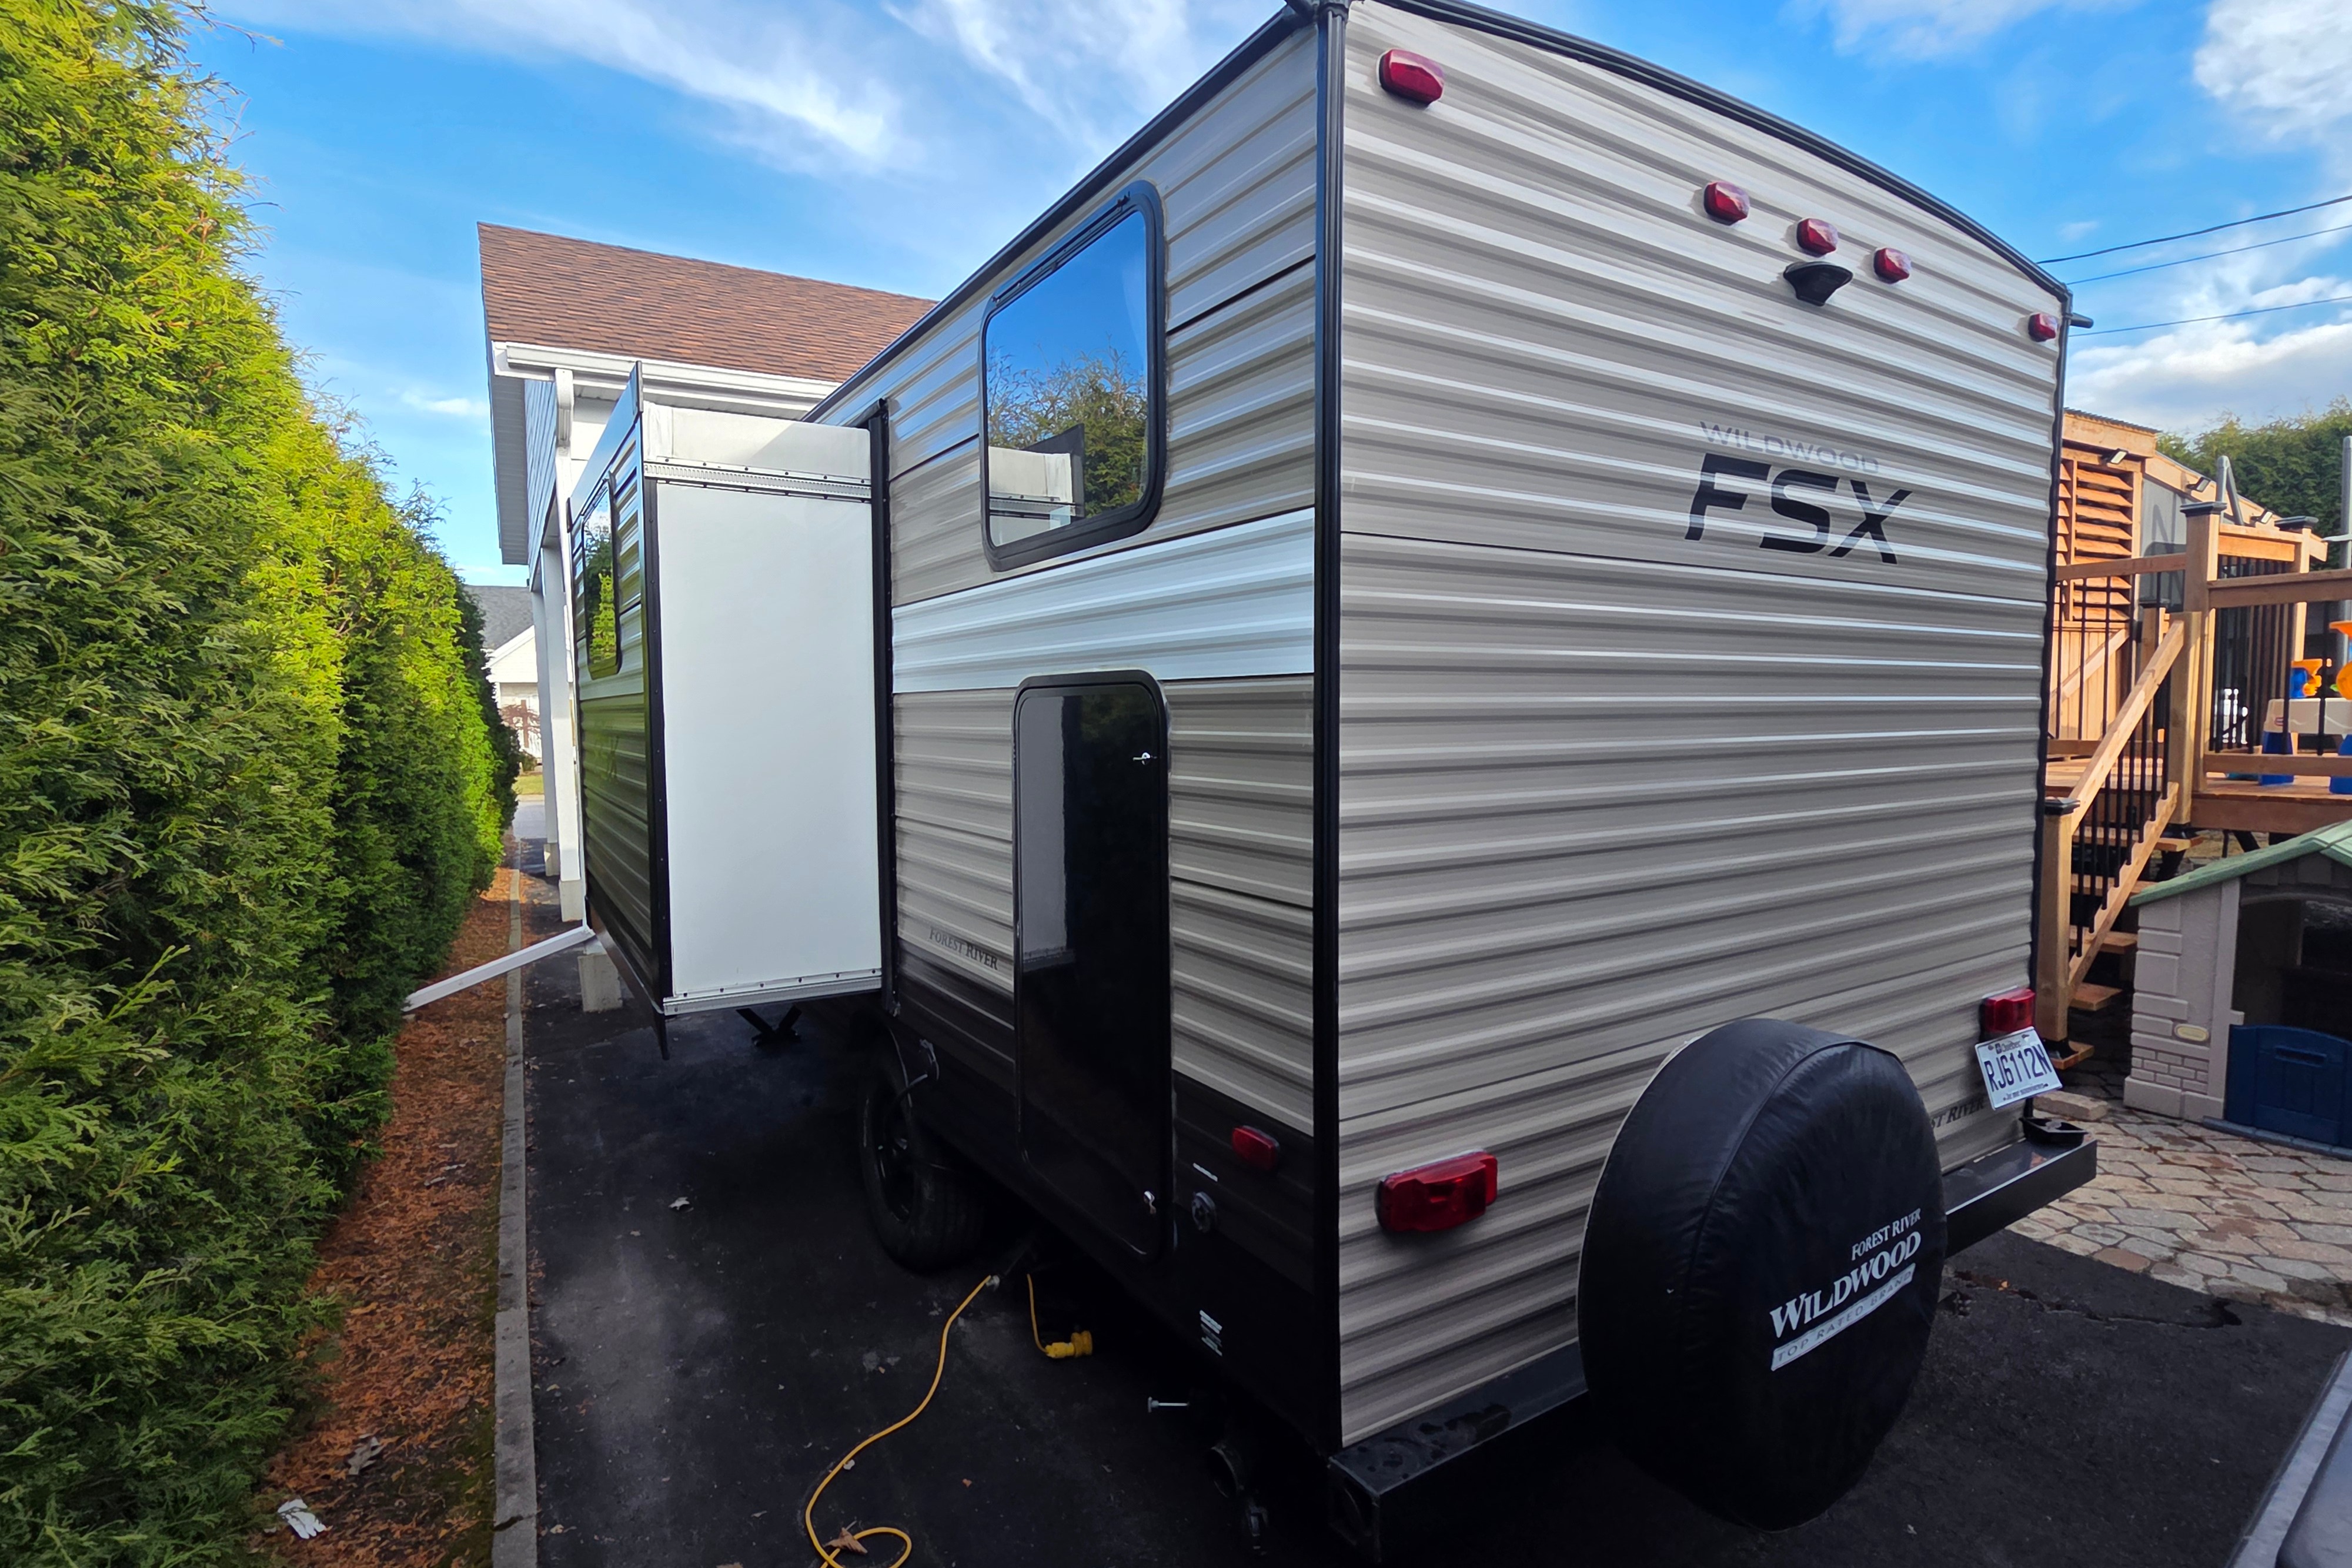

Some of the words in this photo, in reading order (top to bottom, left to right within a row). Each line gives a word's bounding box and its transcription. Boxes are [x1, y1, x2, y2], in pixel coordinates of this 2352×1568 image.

[1700, 421, 1880, 473] WILDWOOD
[1684, 453, 1913, 564] FSX
[929, 927, 964, 954] FOREST
[965, 941, 998, 970] RIVER
[1984, 1044, 2052, 1092] RJ6112N
[1946, 1097, 1984, 1124] RIVER
[1851, 1225, 1890, 1261] FOREST
[1892, 1208, 1921, 1237] RIVER
[1769, 1231, 1921, 1338] WILDWOOD
[1777, 1338, 1809, 1362] TOP
[1816, 1305, 1864, 1340] RATED
[1870, 1271, 1912, 1306] BRAND
